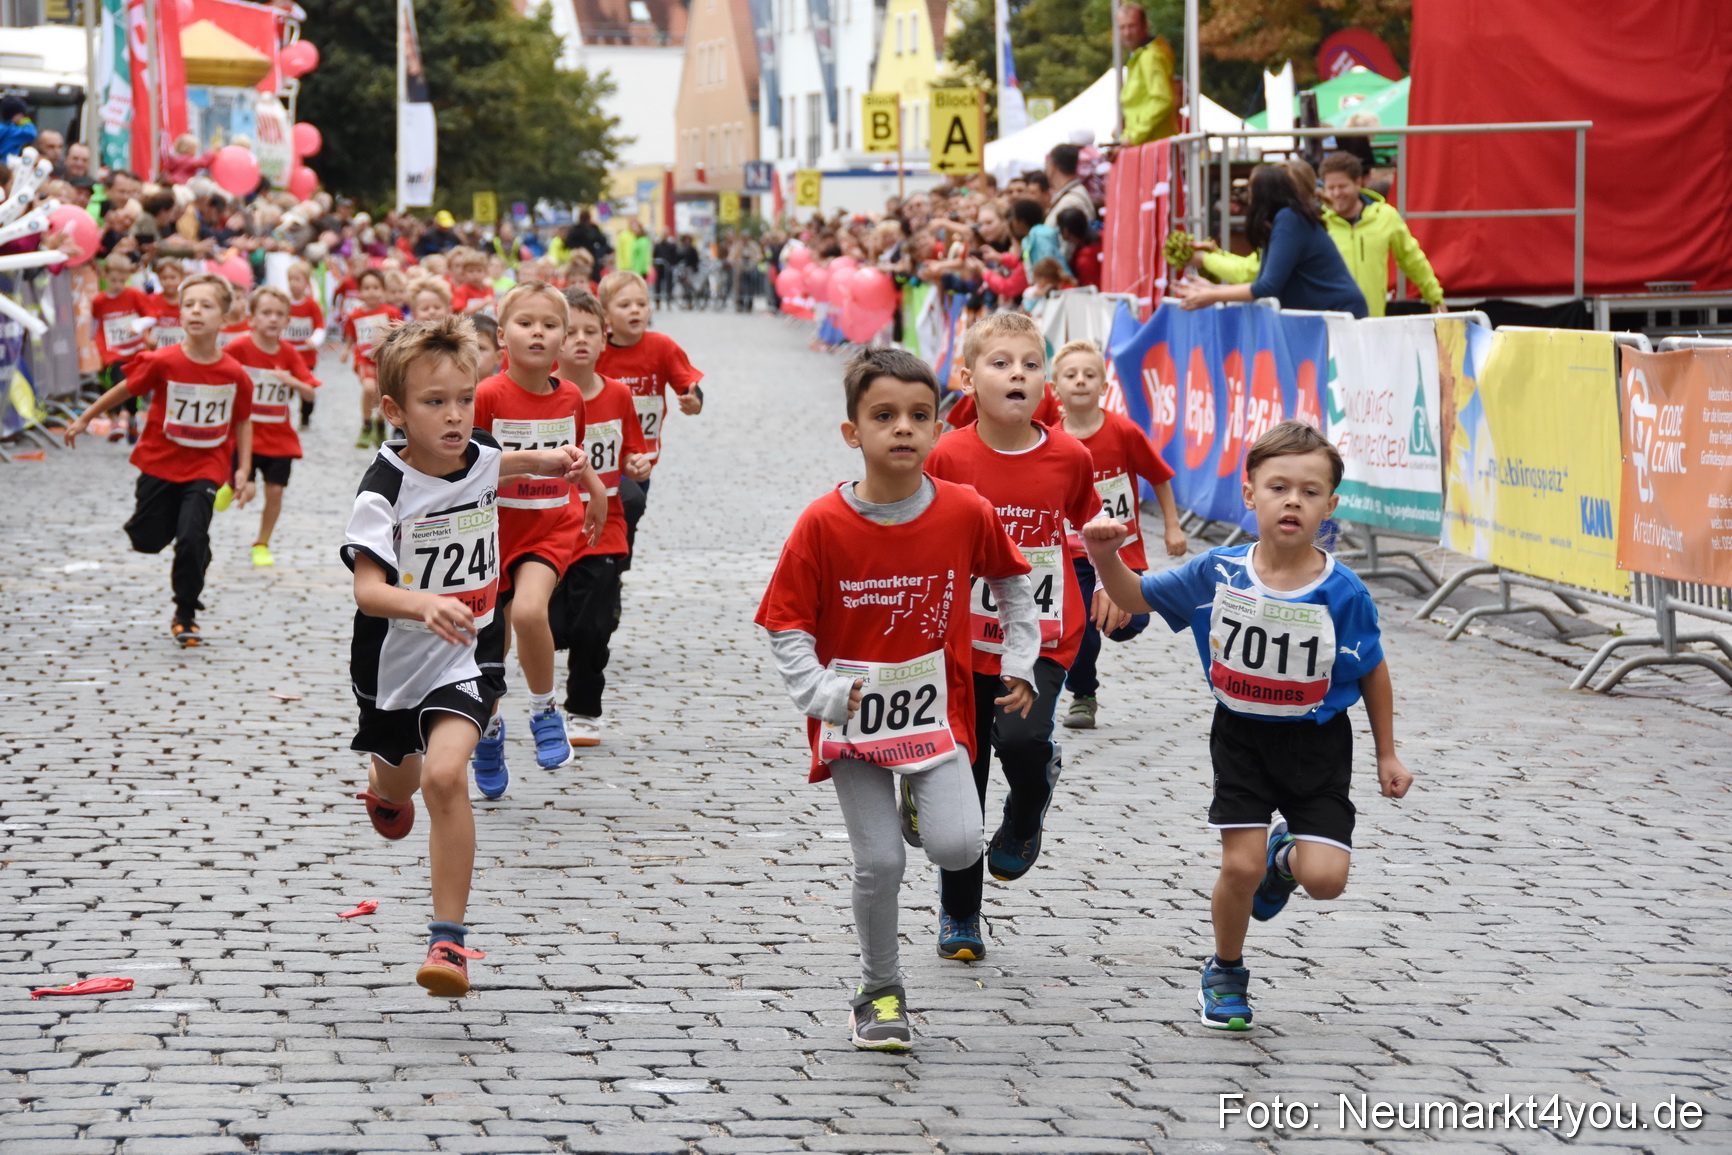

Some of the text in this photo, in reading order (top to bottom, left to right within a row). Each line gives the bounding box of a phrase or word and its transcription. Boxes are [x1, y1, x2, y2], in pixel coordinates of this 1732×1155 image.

[936, 92, 977, 107] Block
[872, 111, 891, 140] B
[942, 114, 972, 154] A
[801, 178, 815, 199] C
[174, 398, 227, 424] 7121
[1658, 405, 1684, 437] CODE
[590, 439, 616, 471] 81
[1651, 441, 1687, 474] CLINIC
[457, 508, 494, 530] BOC
[412, 528, 452, 539] NeuerMarkt
[414, 531, 496, 590] 7244
[839, 575, 924, 592] Neumarkter
[842, 591, 906, 609] Stadtlauf
[936, 569, 955, 639] BAMBINI
[1263, 603, 1323, 625] BOCK
[1213, 652, 1219, 660] 2
[1221, 616, 1319, 677] 7011
[878, 657, 937, 682] BOCK
[455, 683, 483, 703] adidas
[1224, 675, 1305, 702] Johannes
[860, 683, 938, 736] 082
[826, 731, 832, 740] 2
[938, 720, 945, 728] K
[839, 741, 937, 765] Maximilian
